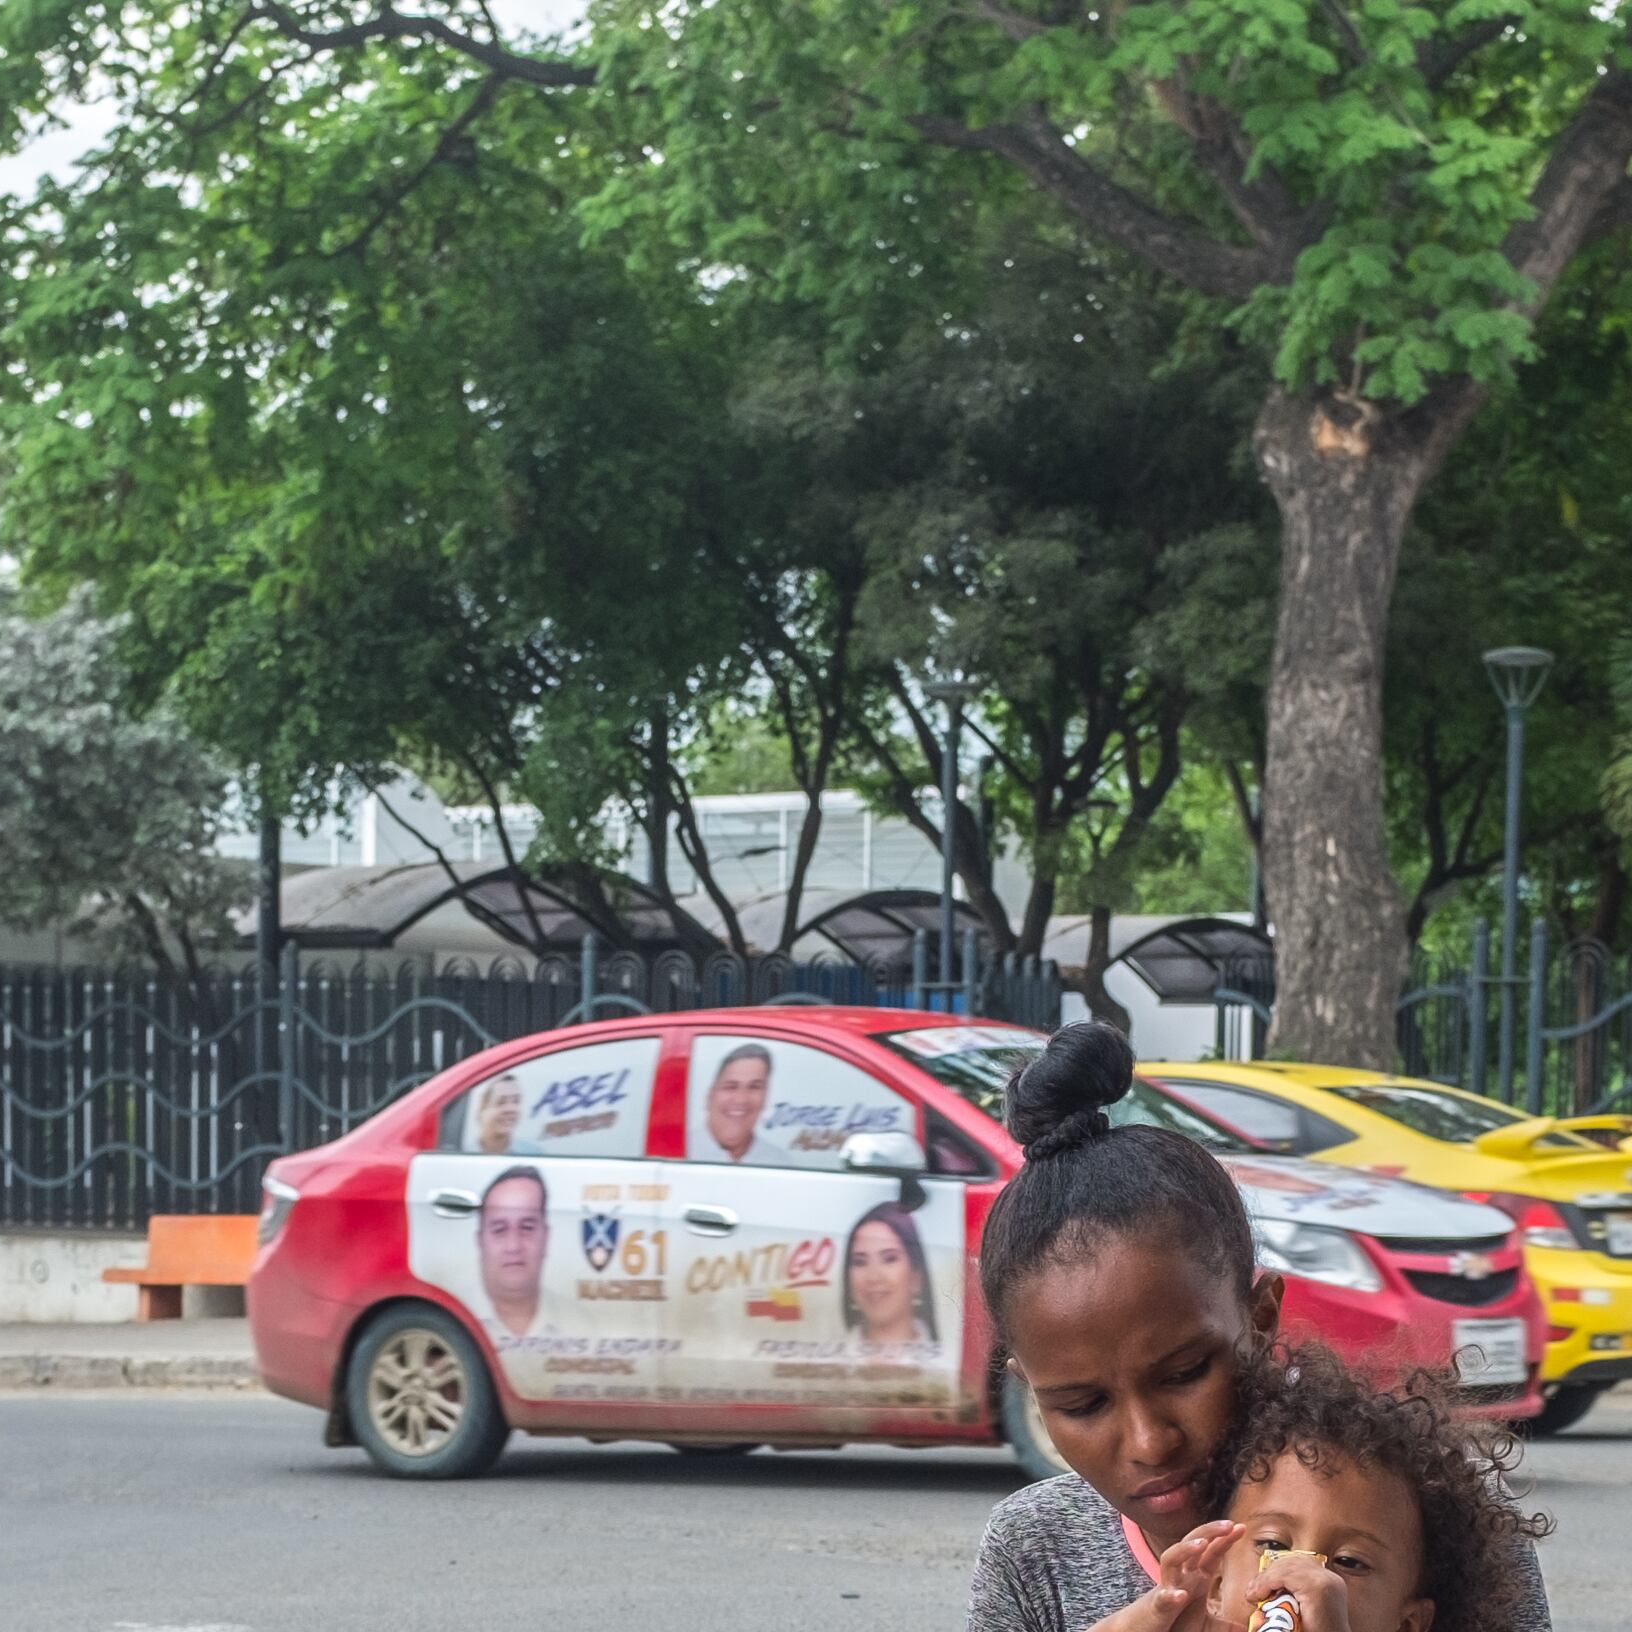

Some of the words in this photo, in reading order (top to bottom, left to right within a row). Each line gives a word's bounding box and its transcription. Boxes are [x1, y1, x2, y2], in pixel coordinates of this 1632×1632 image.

[530, 1067, 632, 1119] ABEL
[622, 1230, 667, 1275] 61
[686, 1237, 835, 1294] CONTIGO
